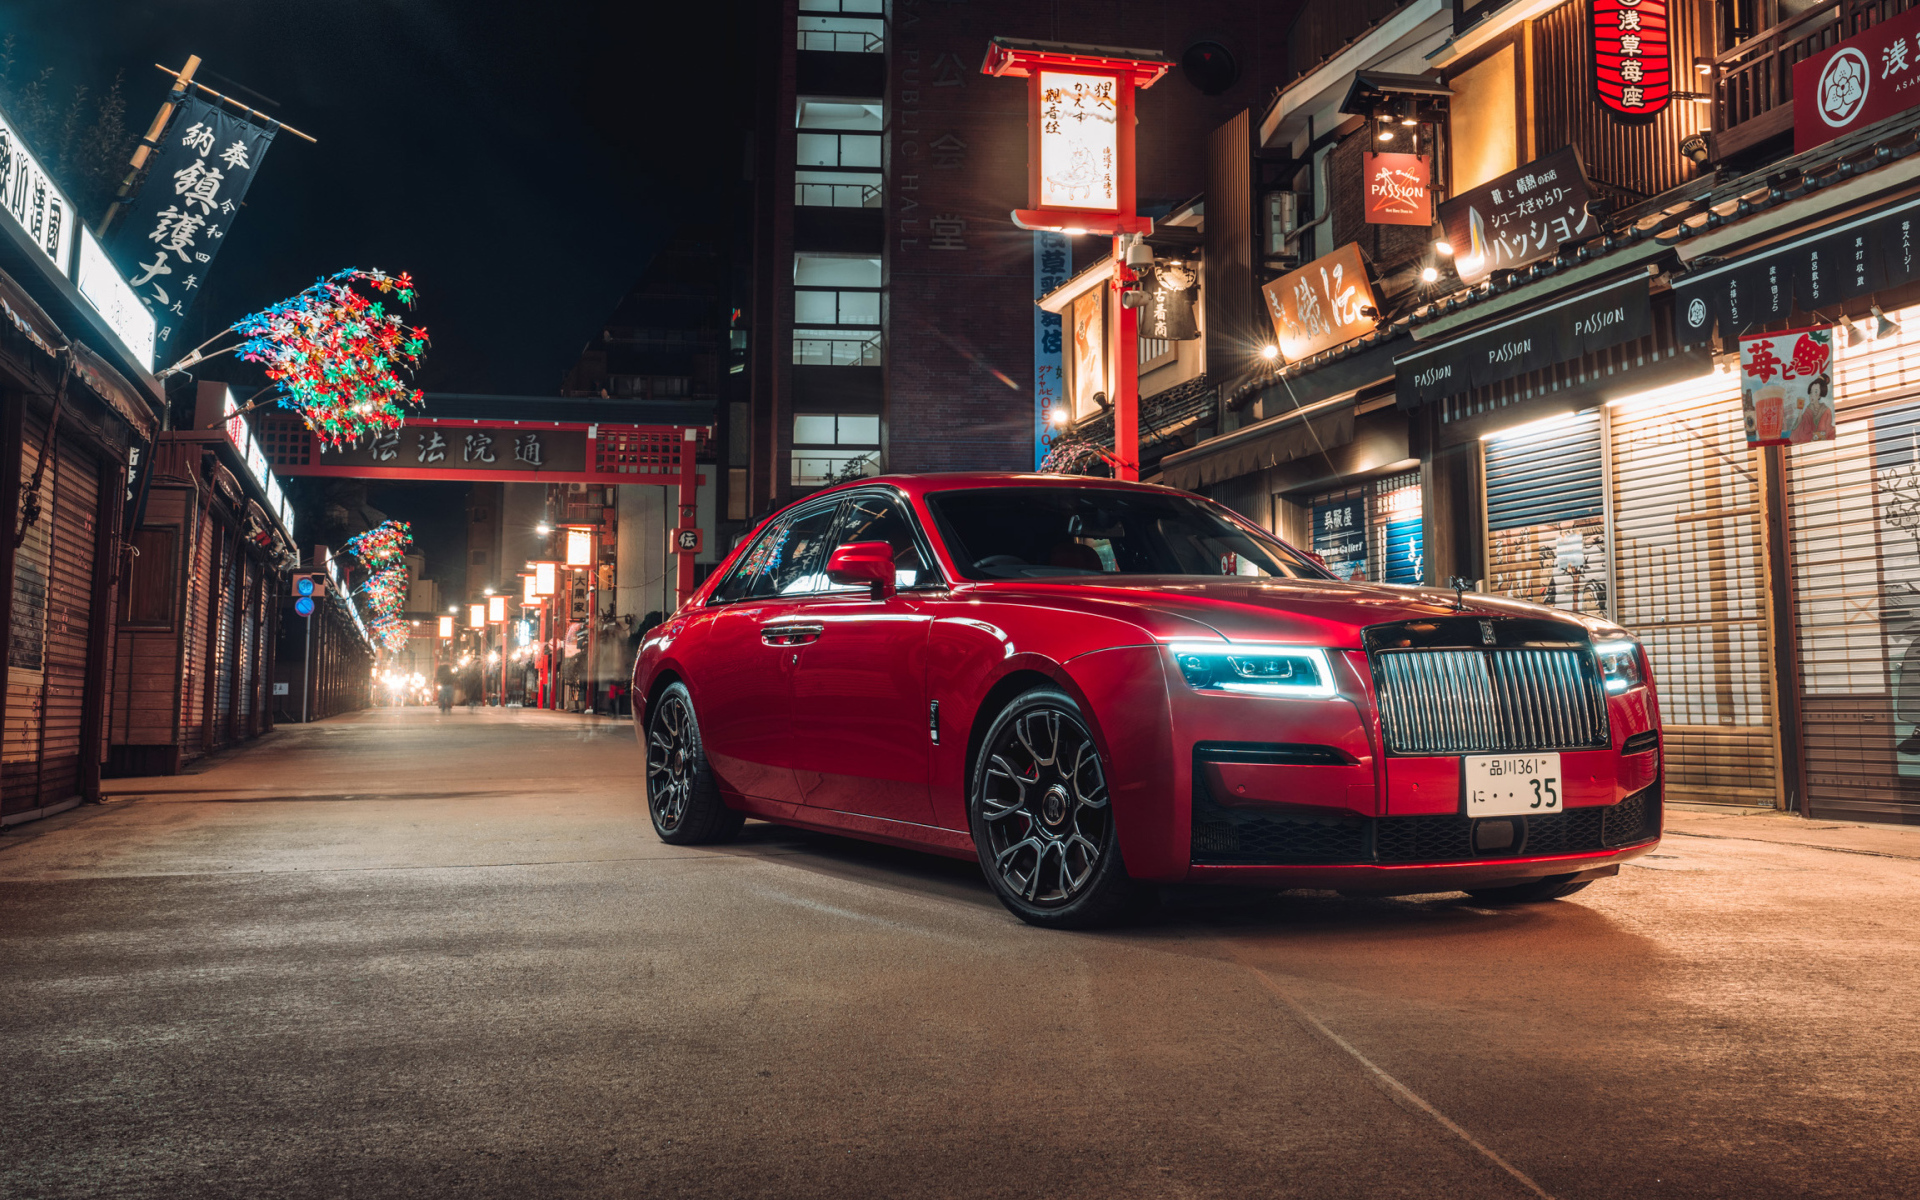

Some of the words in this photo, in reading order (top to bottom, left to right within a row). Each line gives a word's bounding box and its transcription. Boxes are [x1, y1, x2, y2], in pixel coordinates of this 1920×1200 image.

[1618, 9, 1645, 107] 浅草苺座
[901, 50, 919, 156] PUBLIC
[1371, 182, 1424, 199] PASSION
[901, 174, 919, 252] HALL
[130, 159, 224, 313] 鎮護大
[1492, 205, 1590, 266] パッション
[154, 198, 236, 358] 令和四年九月
[1153, 287, 1169, 338] 古着商
[1575, 306, 1625, 336] PASSION
[1488, 338, 1531, 364] PASSION
[1414, 364, 1452, 388] PASSION
[368, 431, 543, 466] 伝法院通
[679, 532, 697, 549] 伝
[1473, 790, 1486, 804] に
